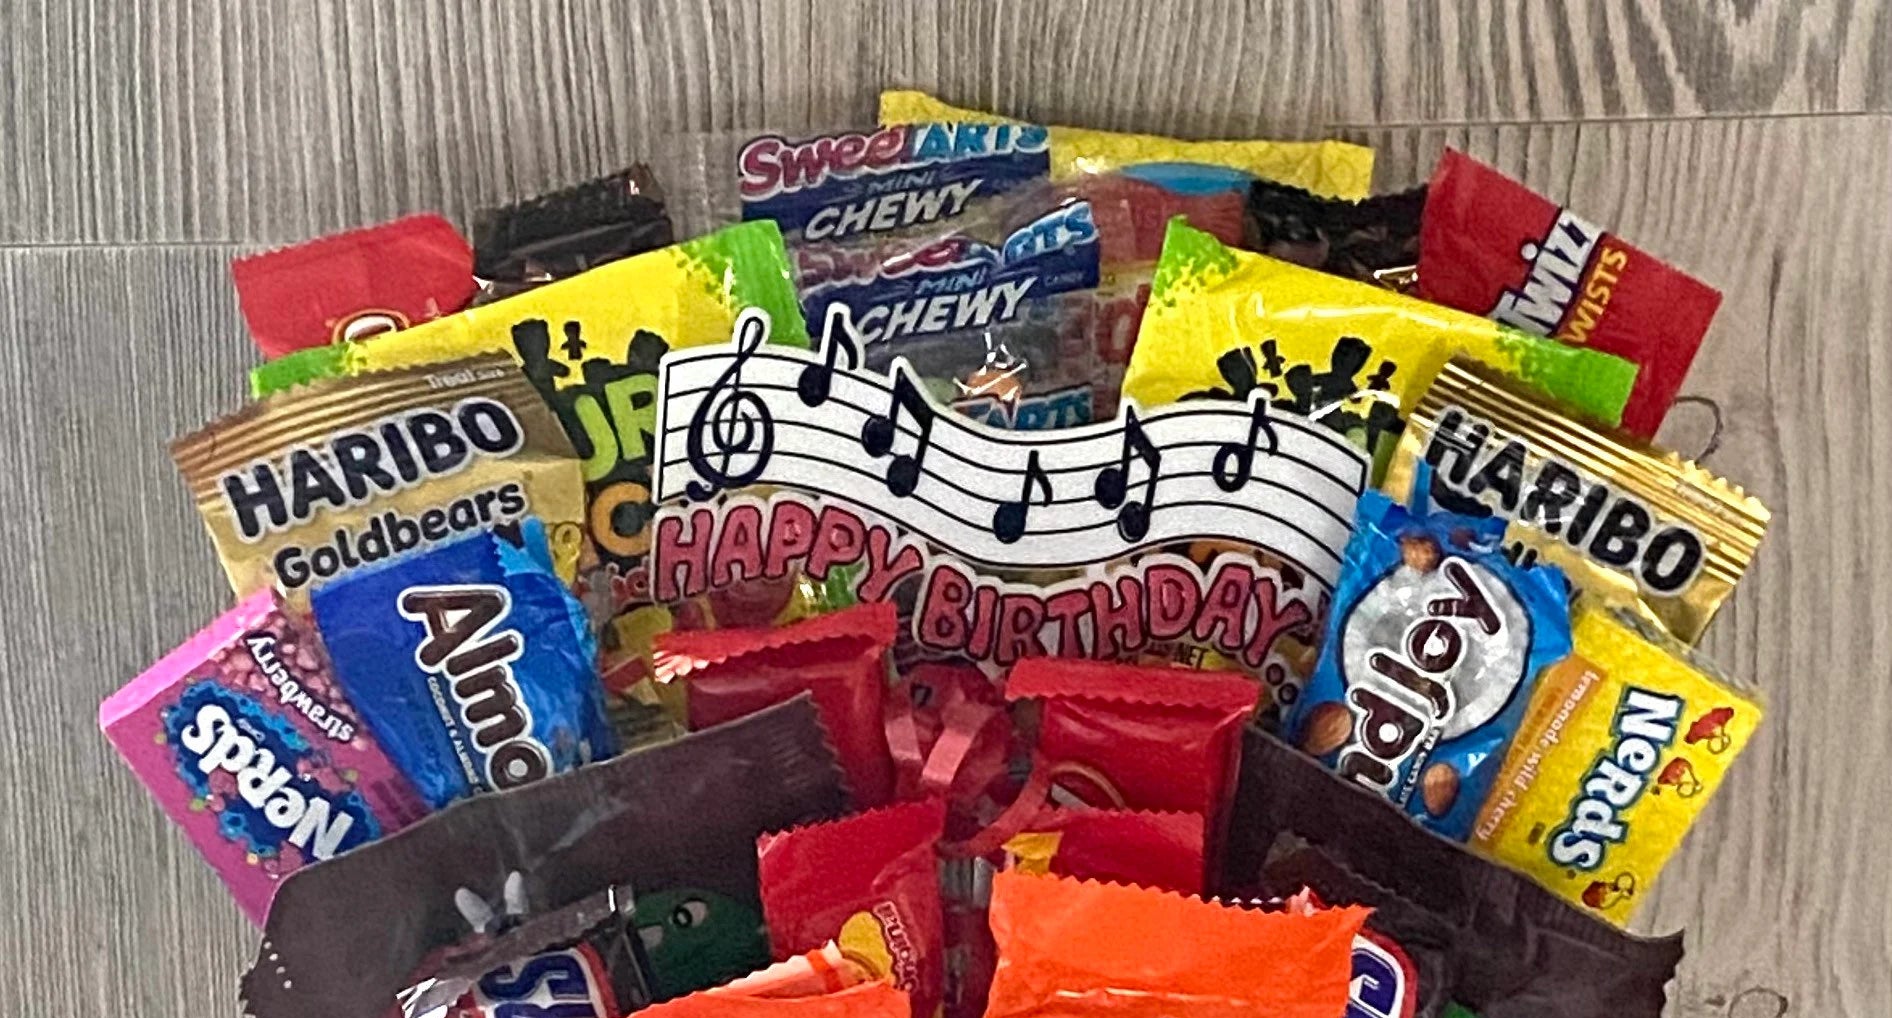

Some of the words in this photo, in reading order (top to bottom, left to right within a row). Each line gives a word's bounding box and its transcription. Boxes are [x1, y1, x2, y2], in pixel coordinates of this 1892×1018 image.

[805, 178, 985, 240] CHEWY
[854, 276, 1038, 345] CHEWY
[222, 399, 520, 538] HARIBO
[1425, 409, 1702, 592] HARIBO
[273, 482, 525, 588] Goldbears
[656, 502, 923, 601] HAPPY
[920, 563, 1311, 667] BIRTHDAY
[245, 632, 355, 745] strawberry
[1538, 670, 1599, 746] lemonade
[1476, 791, 1516, 842] cherry
[1514, 753, 1542, 790] wild
